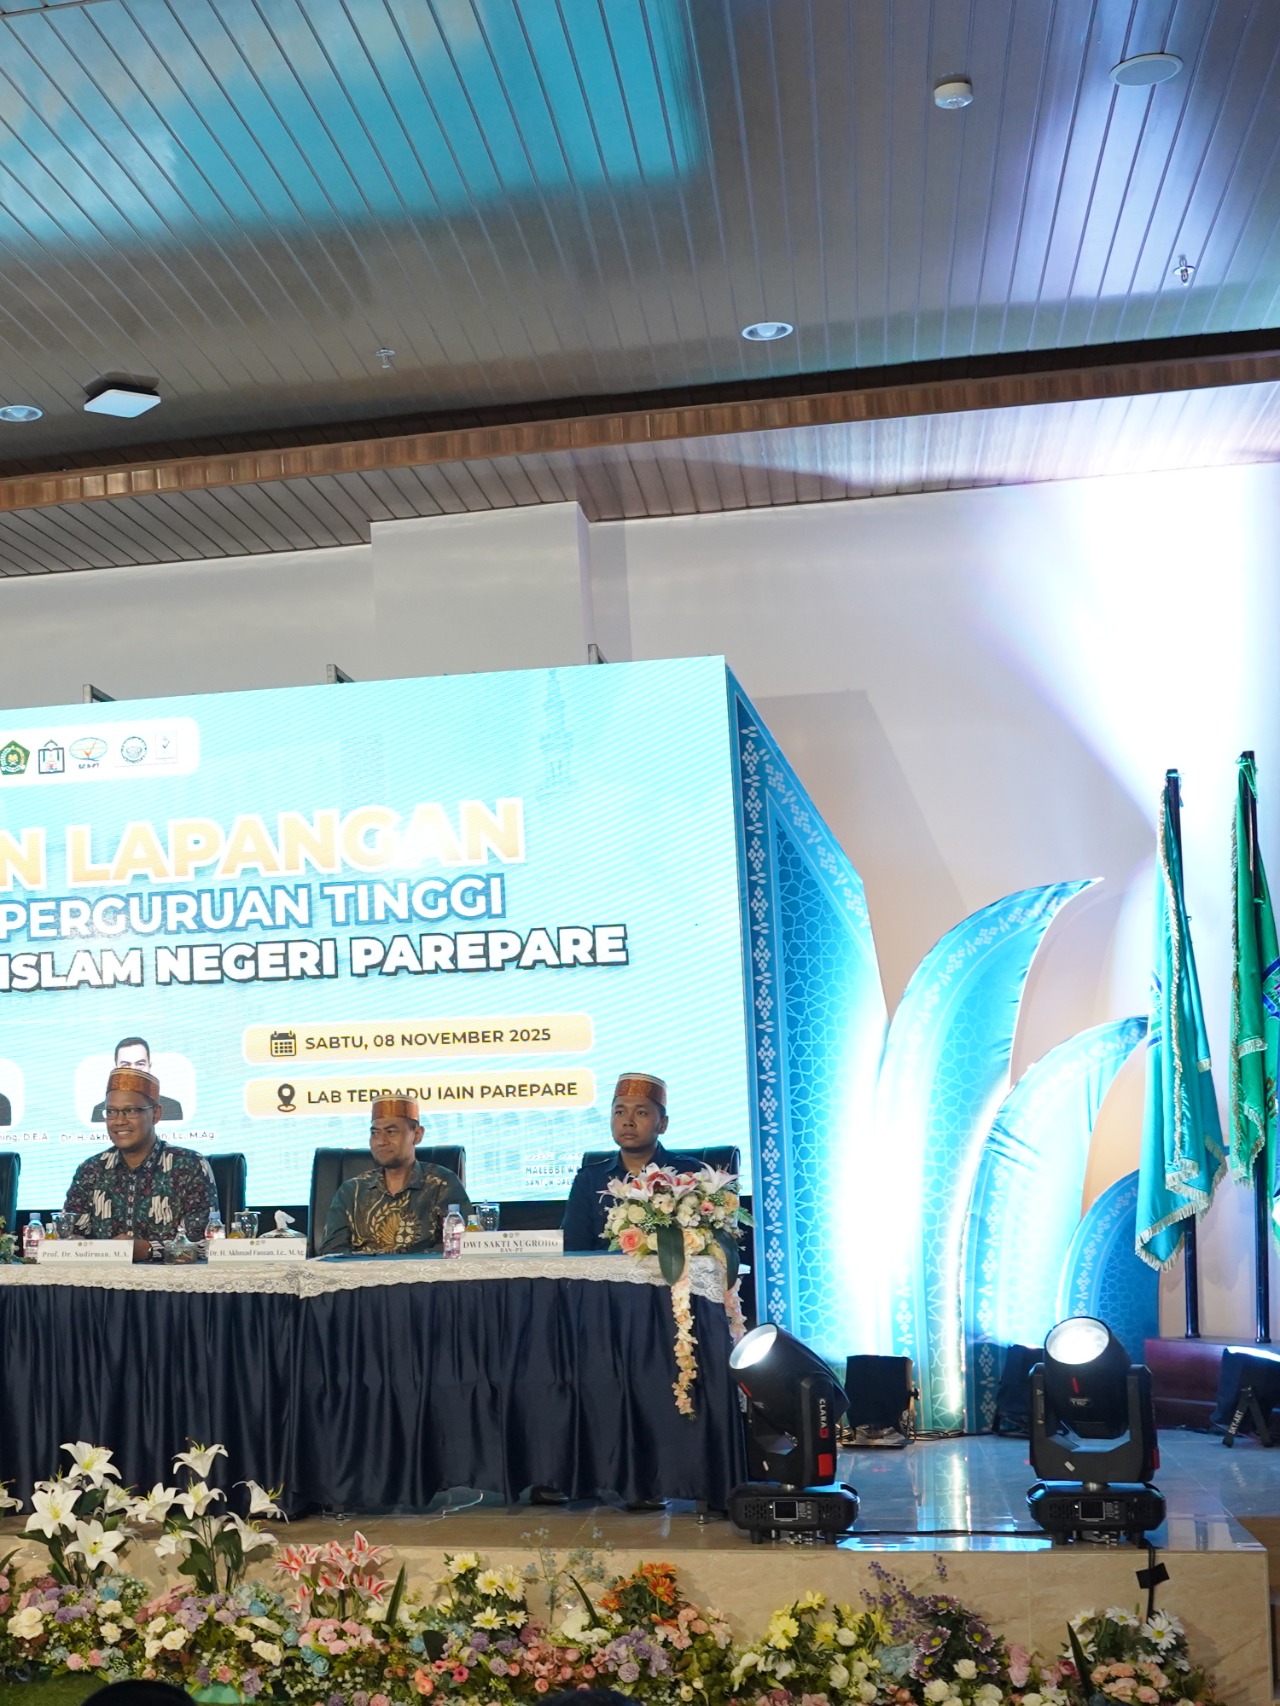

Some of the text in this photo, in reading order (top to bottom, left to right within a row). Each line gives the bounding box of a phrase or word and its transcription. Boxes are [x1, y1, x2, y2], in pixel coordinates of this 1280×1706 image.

[66, 797, 526, 888] LAPANGAN
[320, 873, 506, 925] TINGGI
[155, 938, 338, 985] NEGERI
[350, 924, 629, 977] PAREPARE
[305, 1028, 551, 1050] SABTU, 08 NOVEMBER 2025
[307, 1090, 342, 1104] LAB
[437, 1085, 474, 1100] IAIN
[480, 1082, 578, 1098] PAREPARE
[463, 1241, 481, 1249] DWI
[484, 1240, 510, 1248] SAKTI
